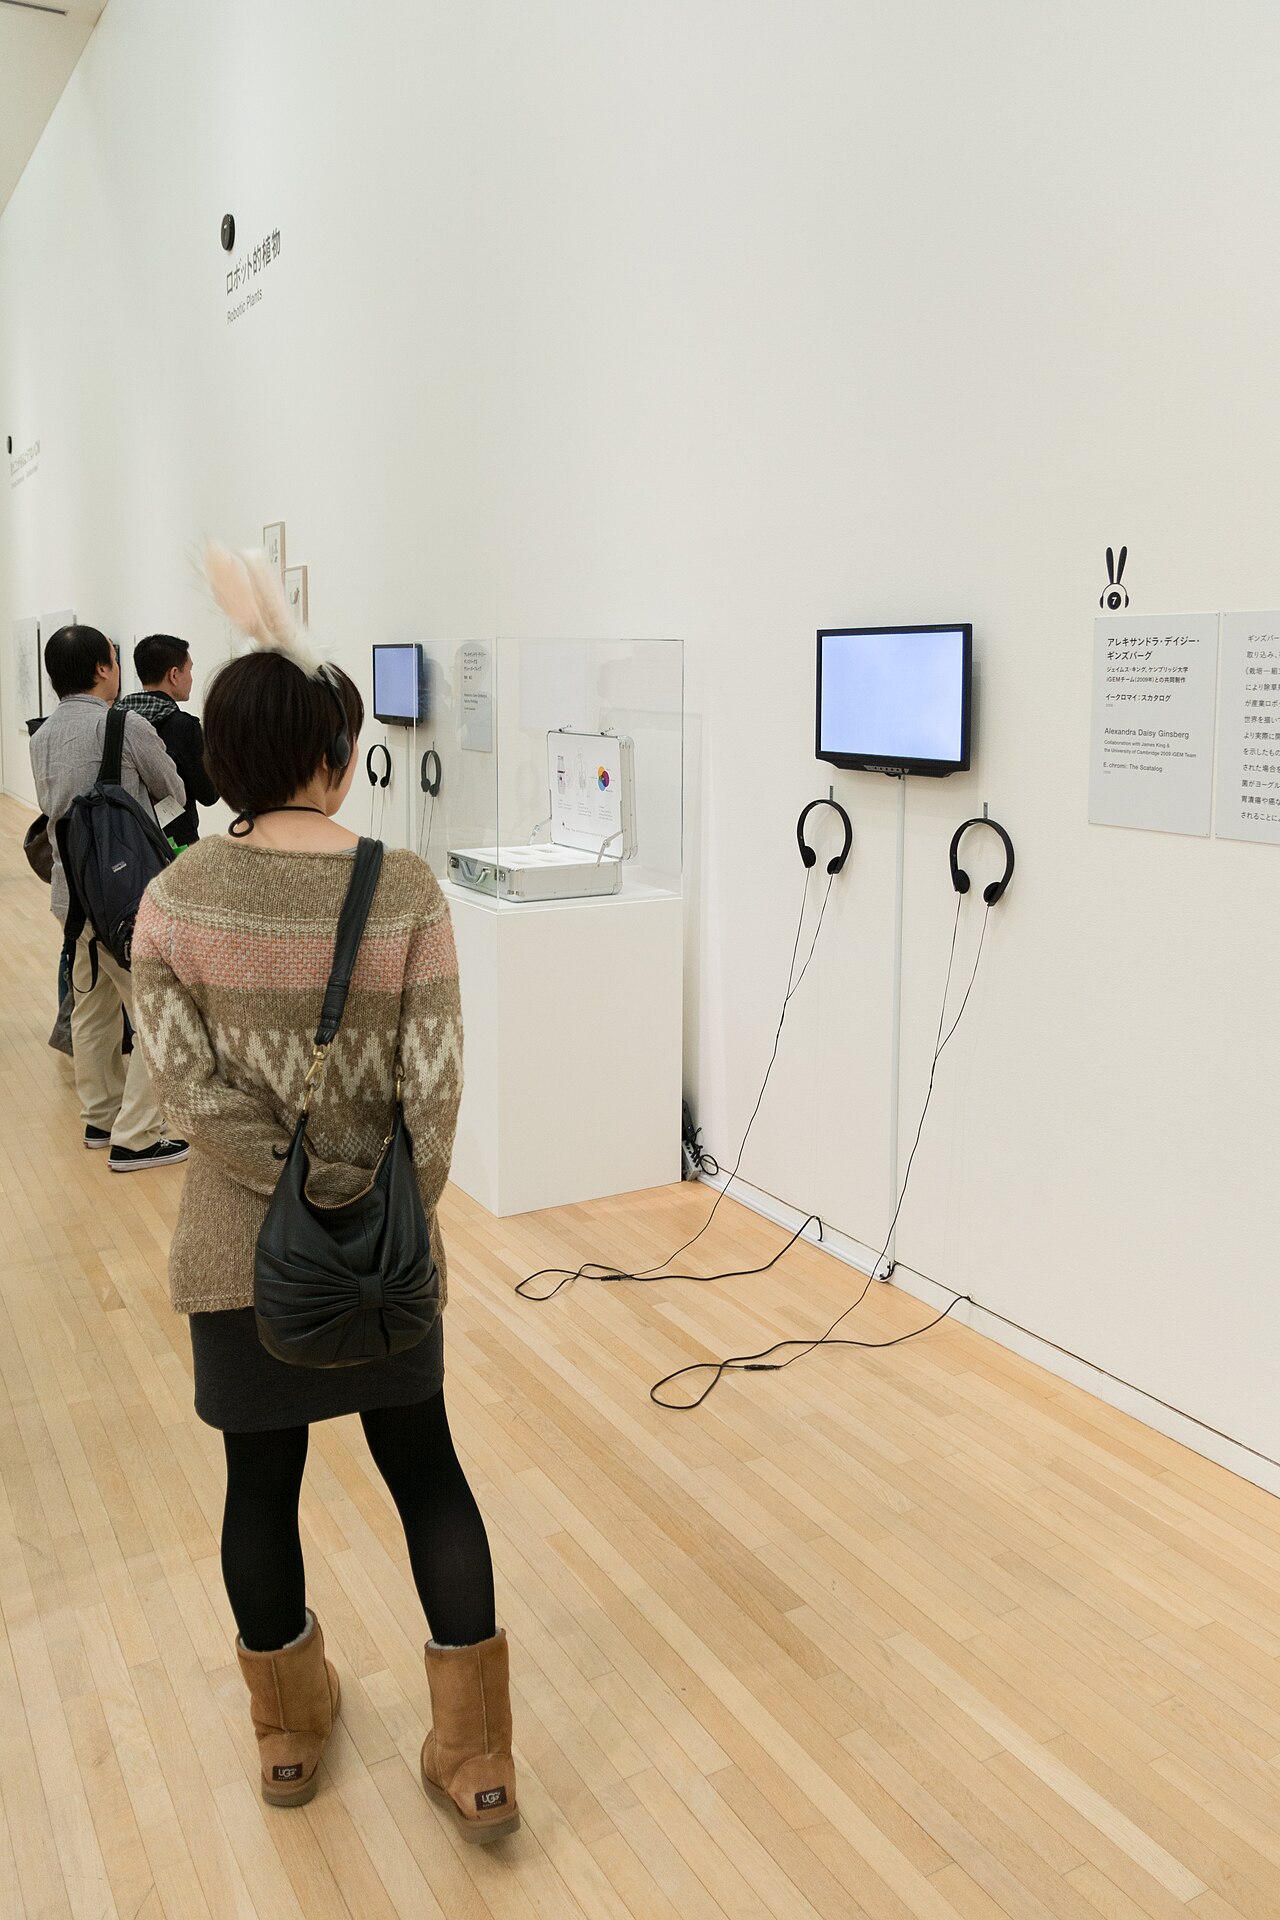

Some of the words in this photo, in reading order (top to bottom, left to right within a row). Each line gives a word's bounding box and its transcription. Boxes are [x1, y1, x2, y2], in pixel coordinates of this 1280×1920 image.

[227, 227, 280, 296] ロボット的植物
[227, 301, 246, 325] Robotic
[246, 289, 262, 310] Plants
[1111, 596, 1118, 606] 7
[1107, 650, 1153, 660] ギンズバーグ
[1245, 699, 1280, 707] が産業ロボ
[1104, 727, 1136, 736] Alexandra
[1138, 729, 1156, 738] Daisy
[1158, 730, 1190, 740] Ginsberg
[1140, 764, 1163, 773] Scatalog
[278, 1768, 296, 1777] UGG
[482, 1791, 500, 1803] UGG
